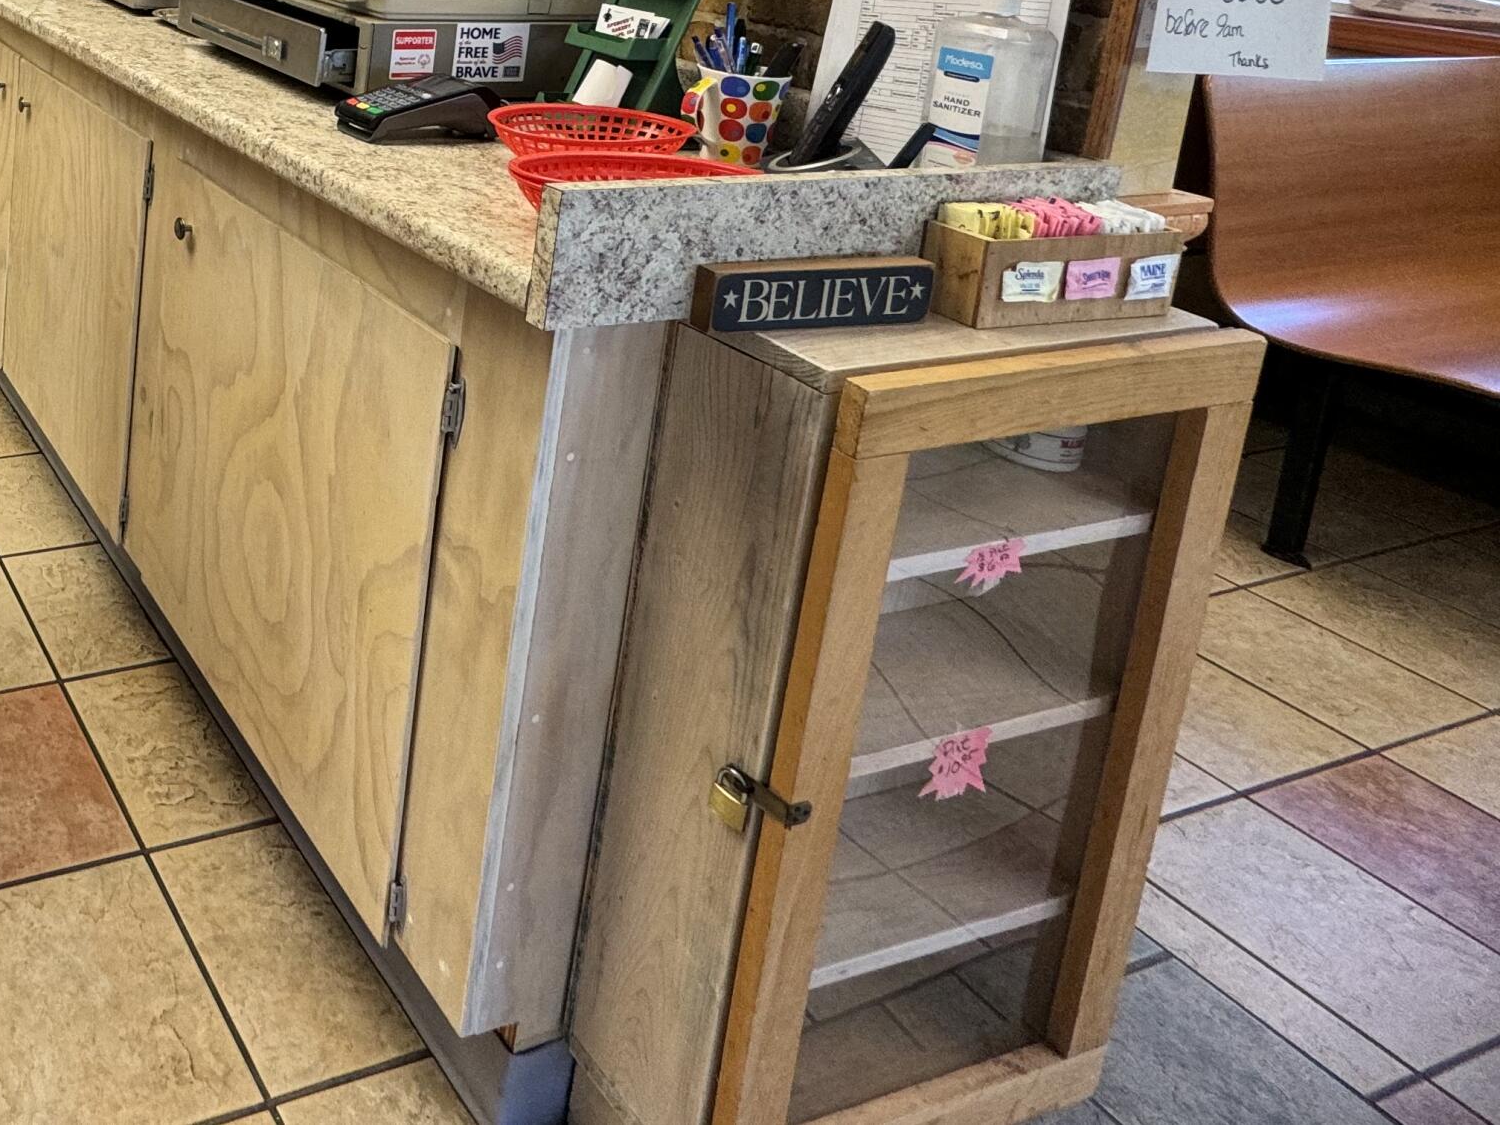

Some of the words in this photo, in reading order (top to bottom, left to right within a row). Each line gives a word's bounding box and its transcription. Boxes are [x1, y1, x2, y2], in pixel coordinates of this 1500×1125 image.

[1165, 8, 1209, 38] before
[1216, 14, 1245, 38] 9am
[460, 27, 501, 40] HOME
[396, 36, 434, 45] SUPPORTER
[457, 46, 489, 59] FREE
[945, 54, 985, 71] Modesa
[1229, 52, 1269, 69] Thanks
[455, 66, 499, 78] BRAVE
[943, 94, 971, 107] HAND
[932, 100, 981, 118] SANITIZER
[1015, 268, 1045, 280] Splenda
[1139, 263, 1167, 276] MAINE
[738, 275, 912, 324] BELIEVE
